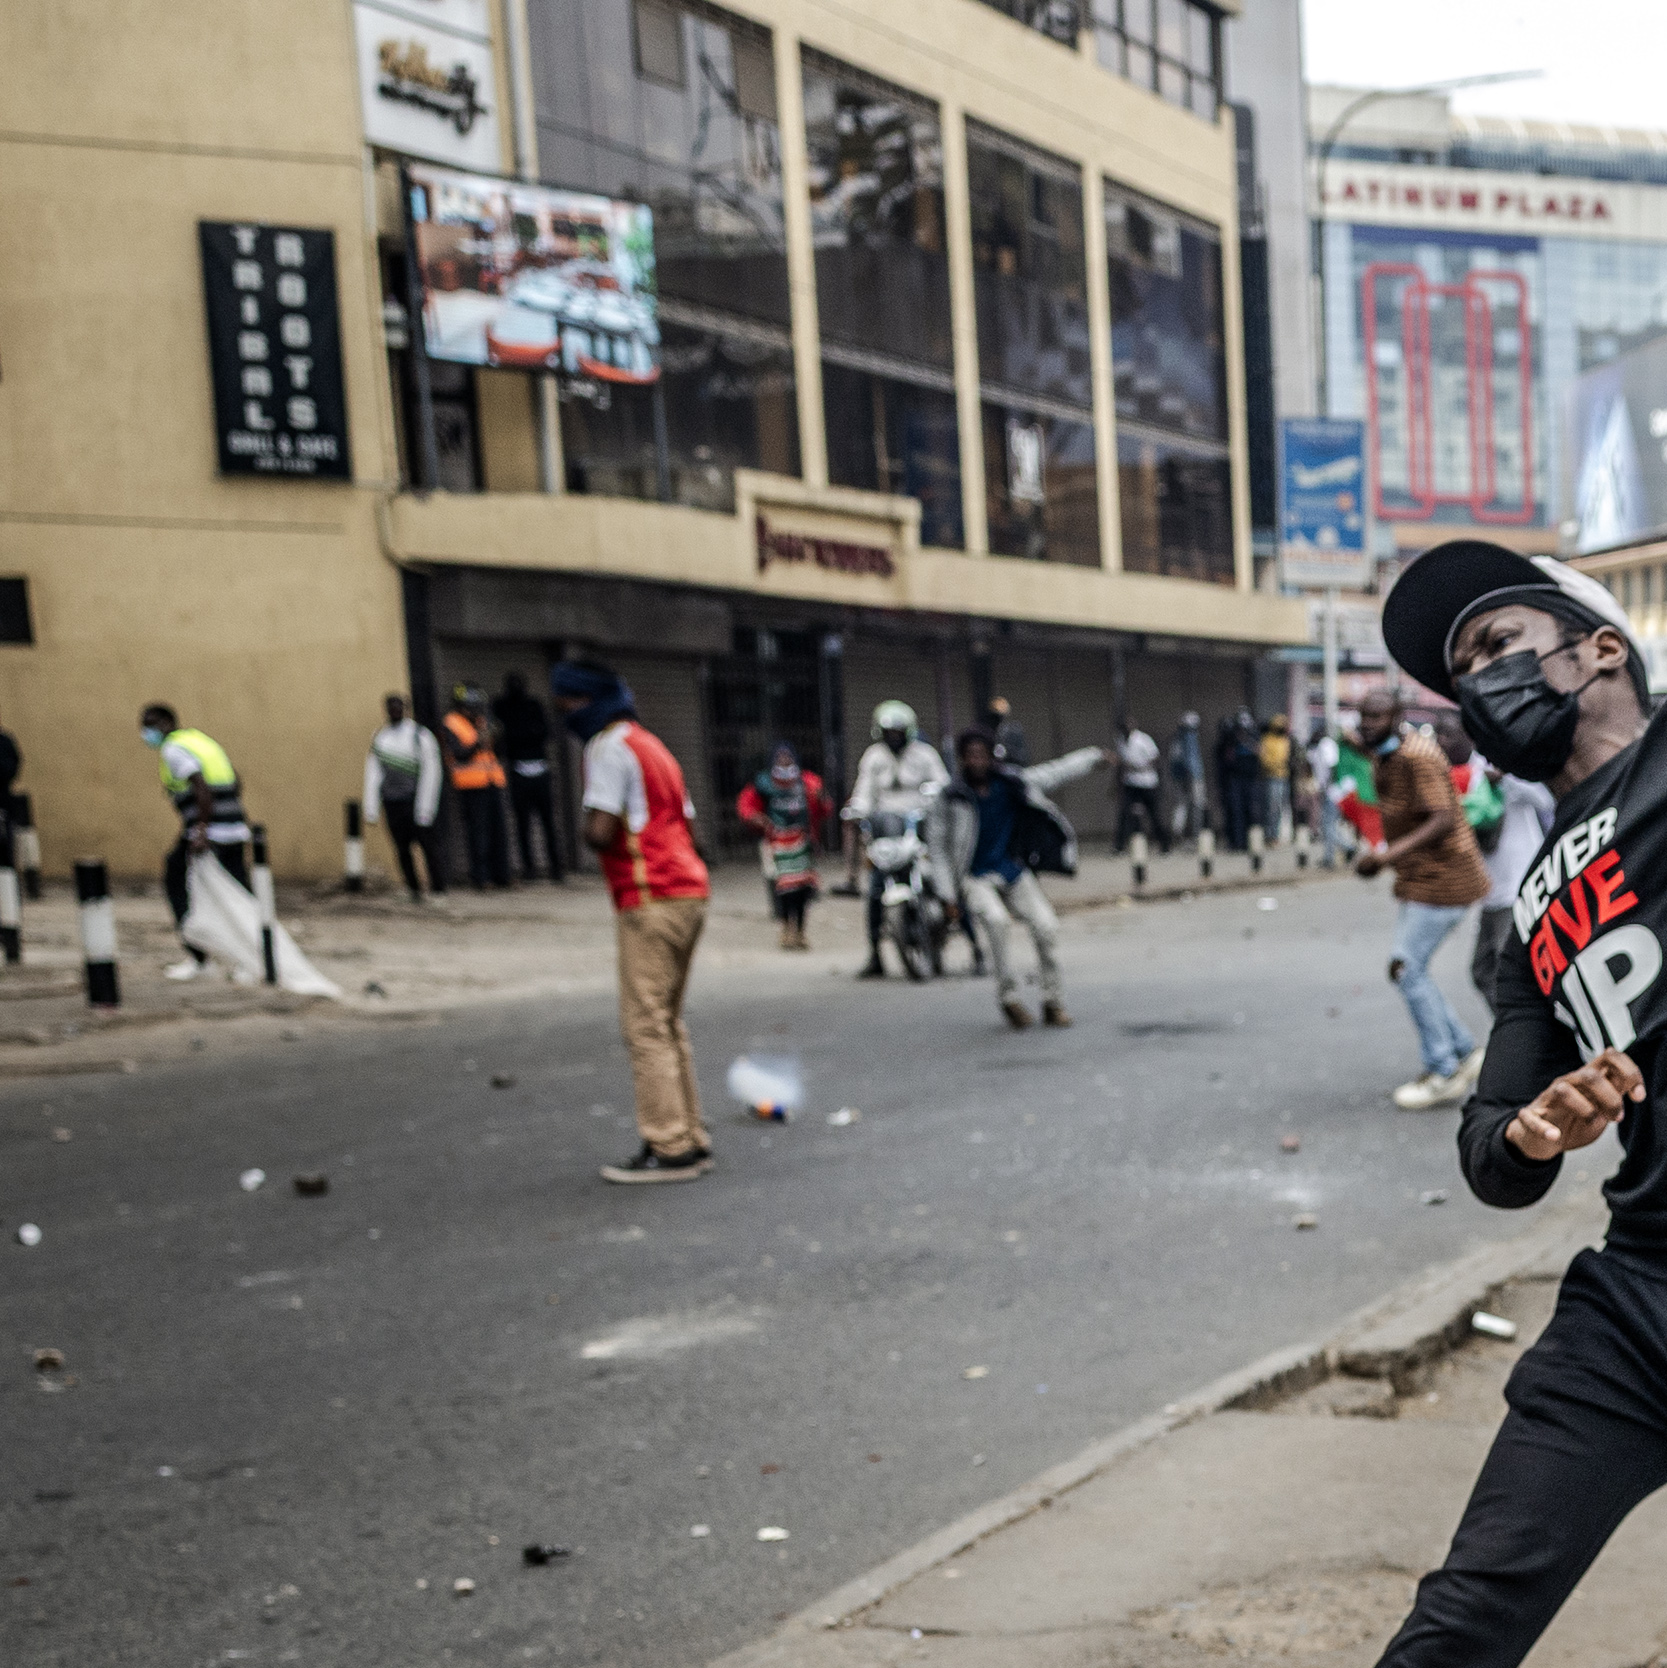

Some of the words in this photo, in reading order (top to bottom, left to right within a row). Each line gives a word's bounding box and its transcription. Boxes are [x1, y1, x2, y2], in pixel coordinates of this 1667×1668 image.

[1496, 191, 1612, 221] PLAZA
[274, 232, 318, 431] ROOTS
[1512, 806, 1618, 944] NEVER
[1530, 849, 1639, 996] GIVE
[1553, 923, 1663, 1065] UP
